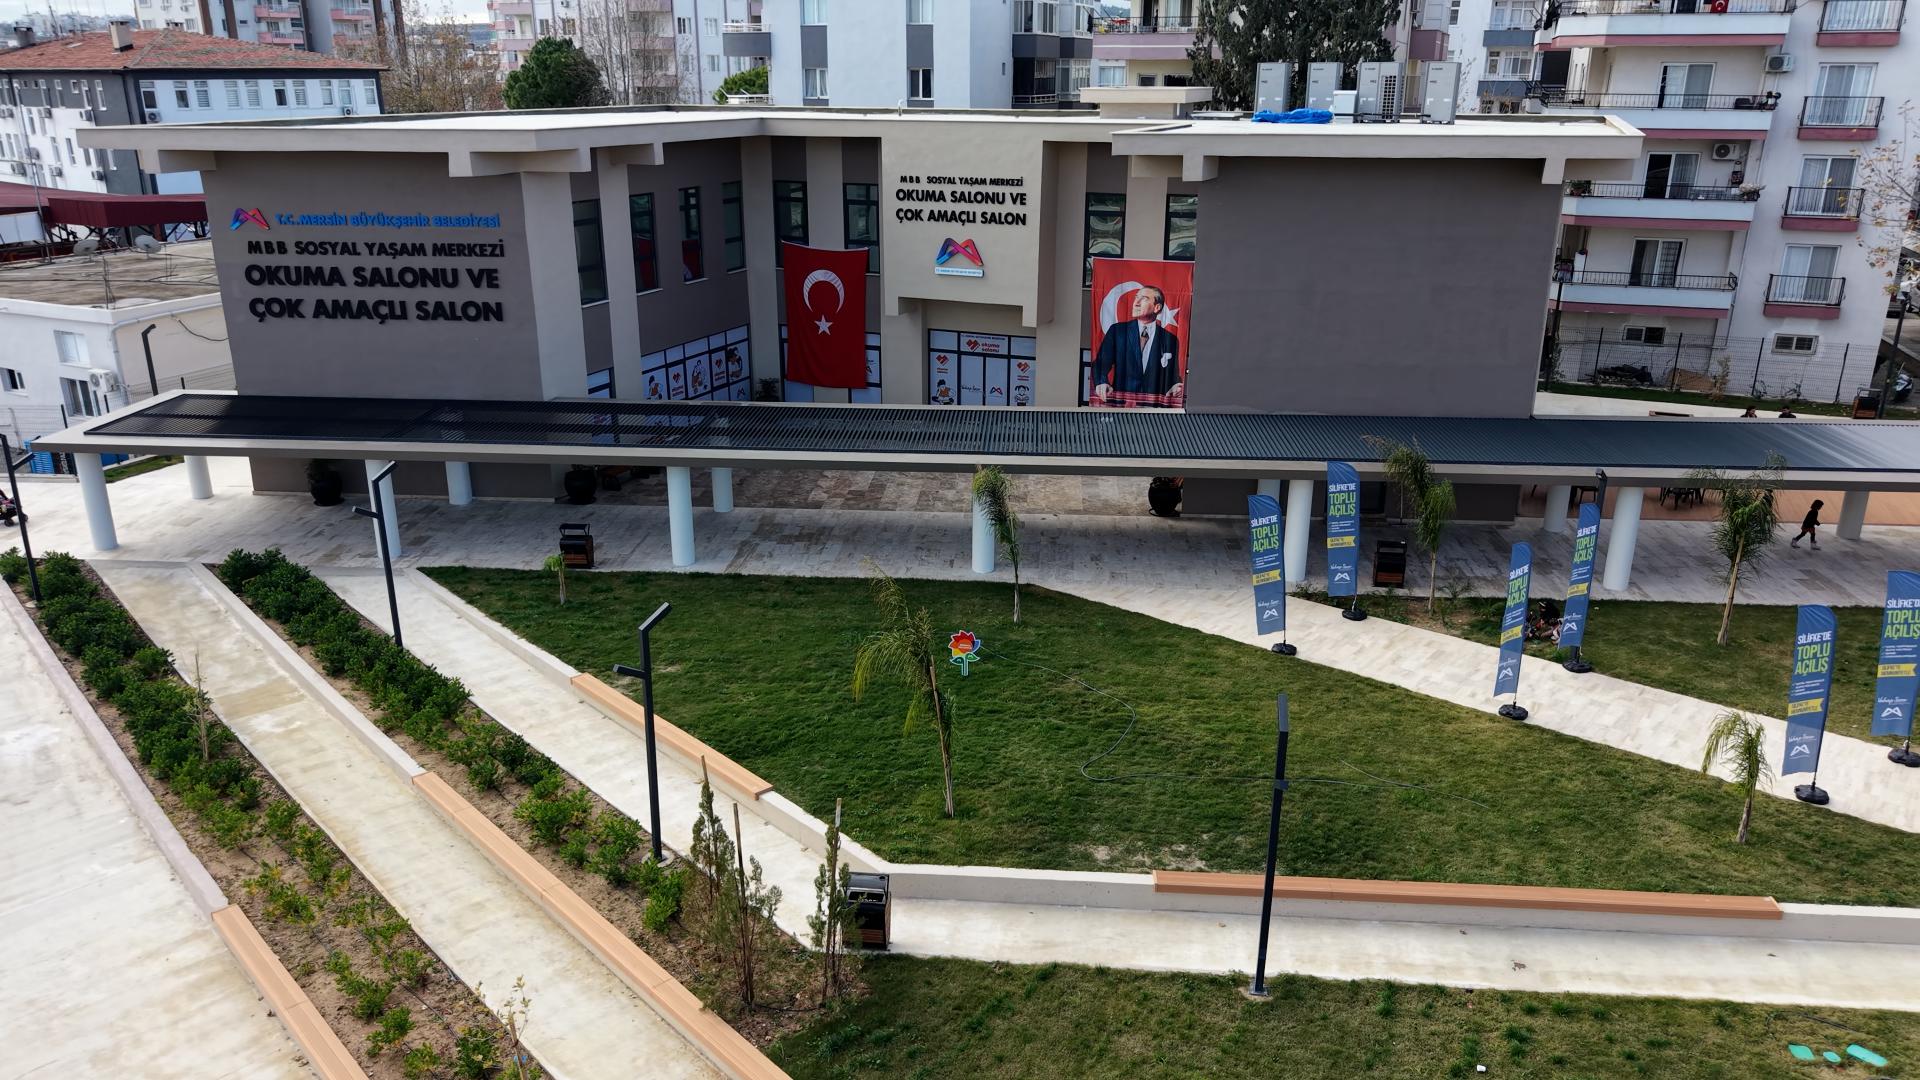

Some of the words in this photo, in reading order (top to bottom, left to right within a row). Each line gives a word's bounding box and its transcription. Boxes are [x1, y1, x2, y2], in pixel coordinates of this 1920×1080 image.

[926, 176, 956, 185] SOSYAL
[958, 177, 987, 187] YAŞAM
[989, 176, 1024, 187] MERKEZİ
[896, 189, 946, 203] OKUMA
[950, 190, 1006, 205] SALONU
[1009, 192, 1027, 206] VE
[299, 211, 348, 227] MERSİN
[350, 211, 431, 229] BÜYÜKŞEHİR
[431, 212, 501, 229] BELEDİYESİ
[896, 208, 924, 223] ÇOK
[927, 209, 977, 226] AMAÇLI
[980, 211, 1027, 226] SALON
[295, 240, 361, 256] SOSYAL
[364, 242, 428, 259] YAŞAM
[431, 239, 505, 258] MERKEZİ
[244, 264, 346, 287] OKUMA
[352, 266, 459, 289] SALONU
[467, 268, 500, 289] VE
[248, 297, 306, 322] ÇOK
[312, 299, 408, 325] AMAÇLI
[416, 301, 504, 322] SALON
[1328, 492, 1356, 505] TOPLU
[1329, 504, 1356, 518] AÇILIŞ
[1251, 524, 1279, 539] TOPLU
[1253, 536, 1280, 552] AÇILIŞ
[1884, 624, 1920, 639] AÇILIŞ
[1796, 641, 1831, 661] TOPLU
[1794, 656, 1829, 676] AÇILIŞ
